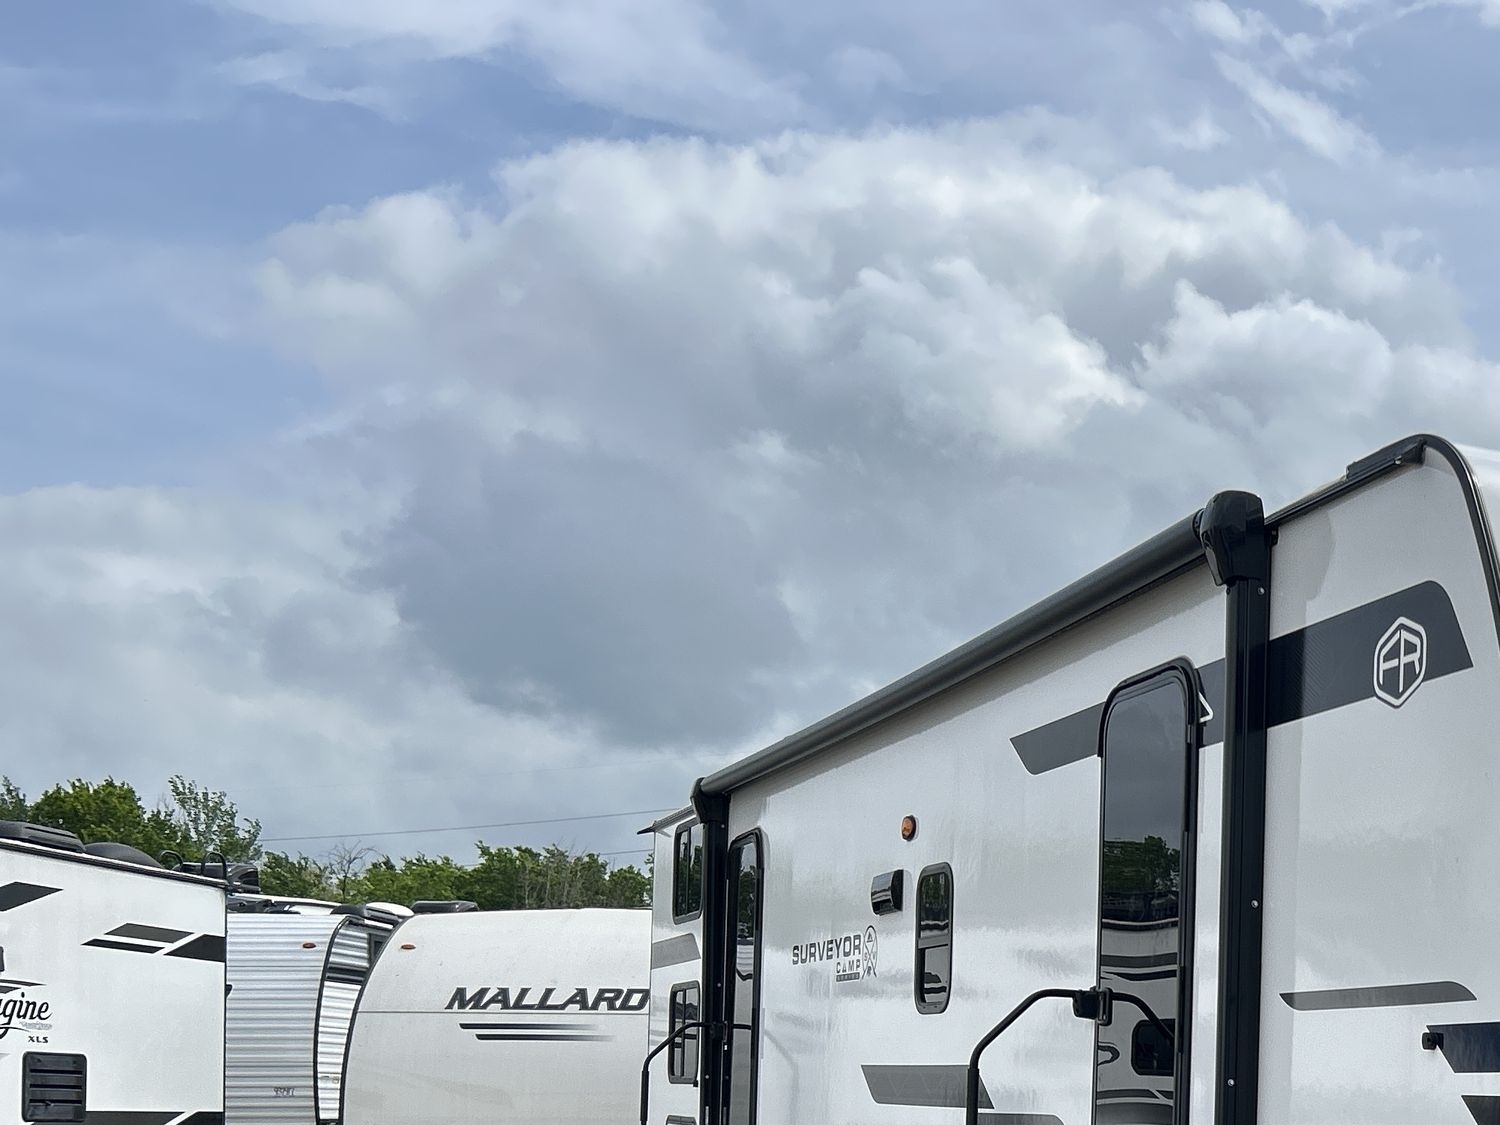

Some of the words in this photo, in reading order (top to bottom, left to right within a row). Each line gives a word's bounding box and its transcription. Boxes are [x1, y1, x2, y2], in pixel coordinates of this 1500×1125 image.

[792, 934, 861, 966] SURVEYOR
[836, 959, 860, 974] CAMP
[444, 986, 650, 1011] MALLARD
[0, 991, 53, 1039] gine
[28, 1035, 49, 1044] XLS
